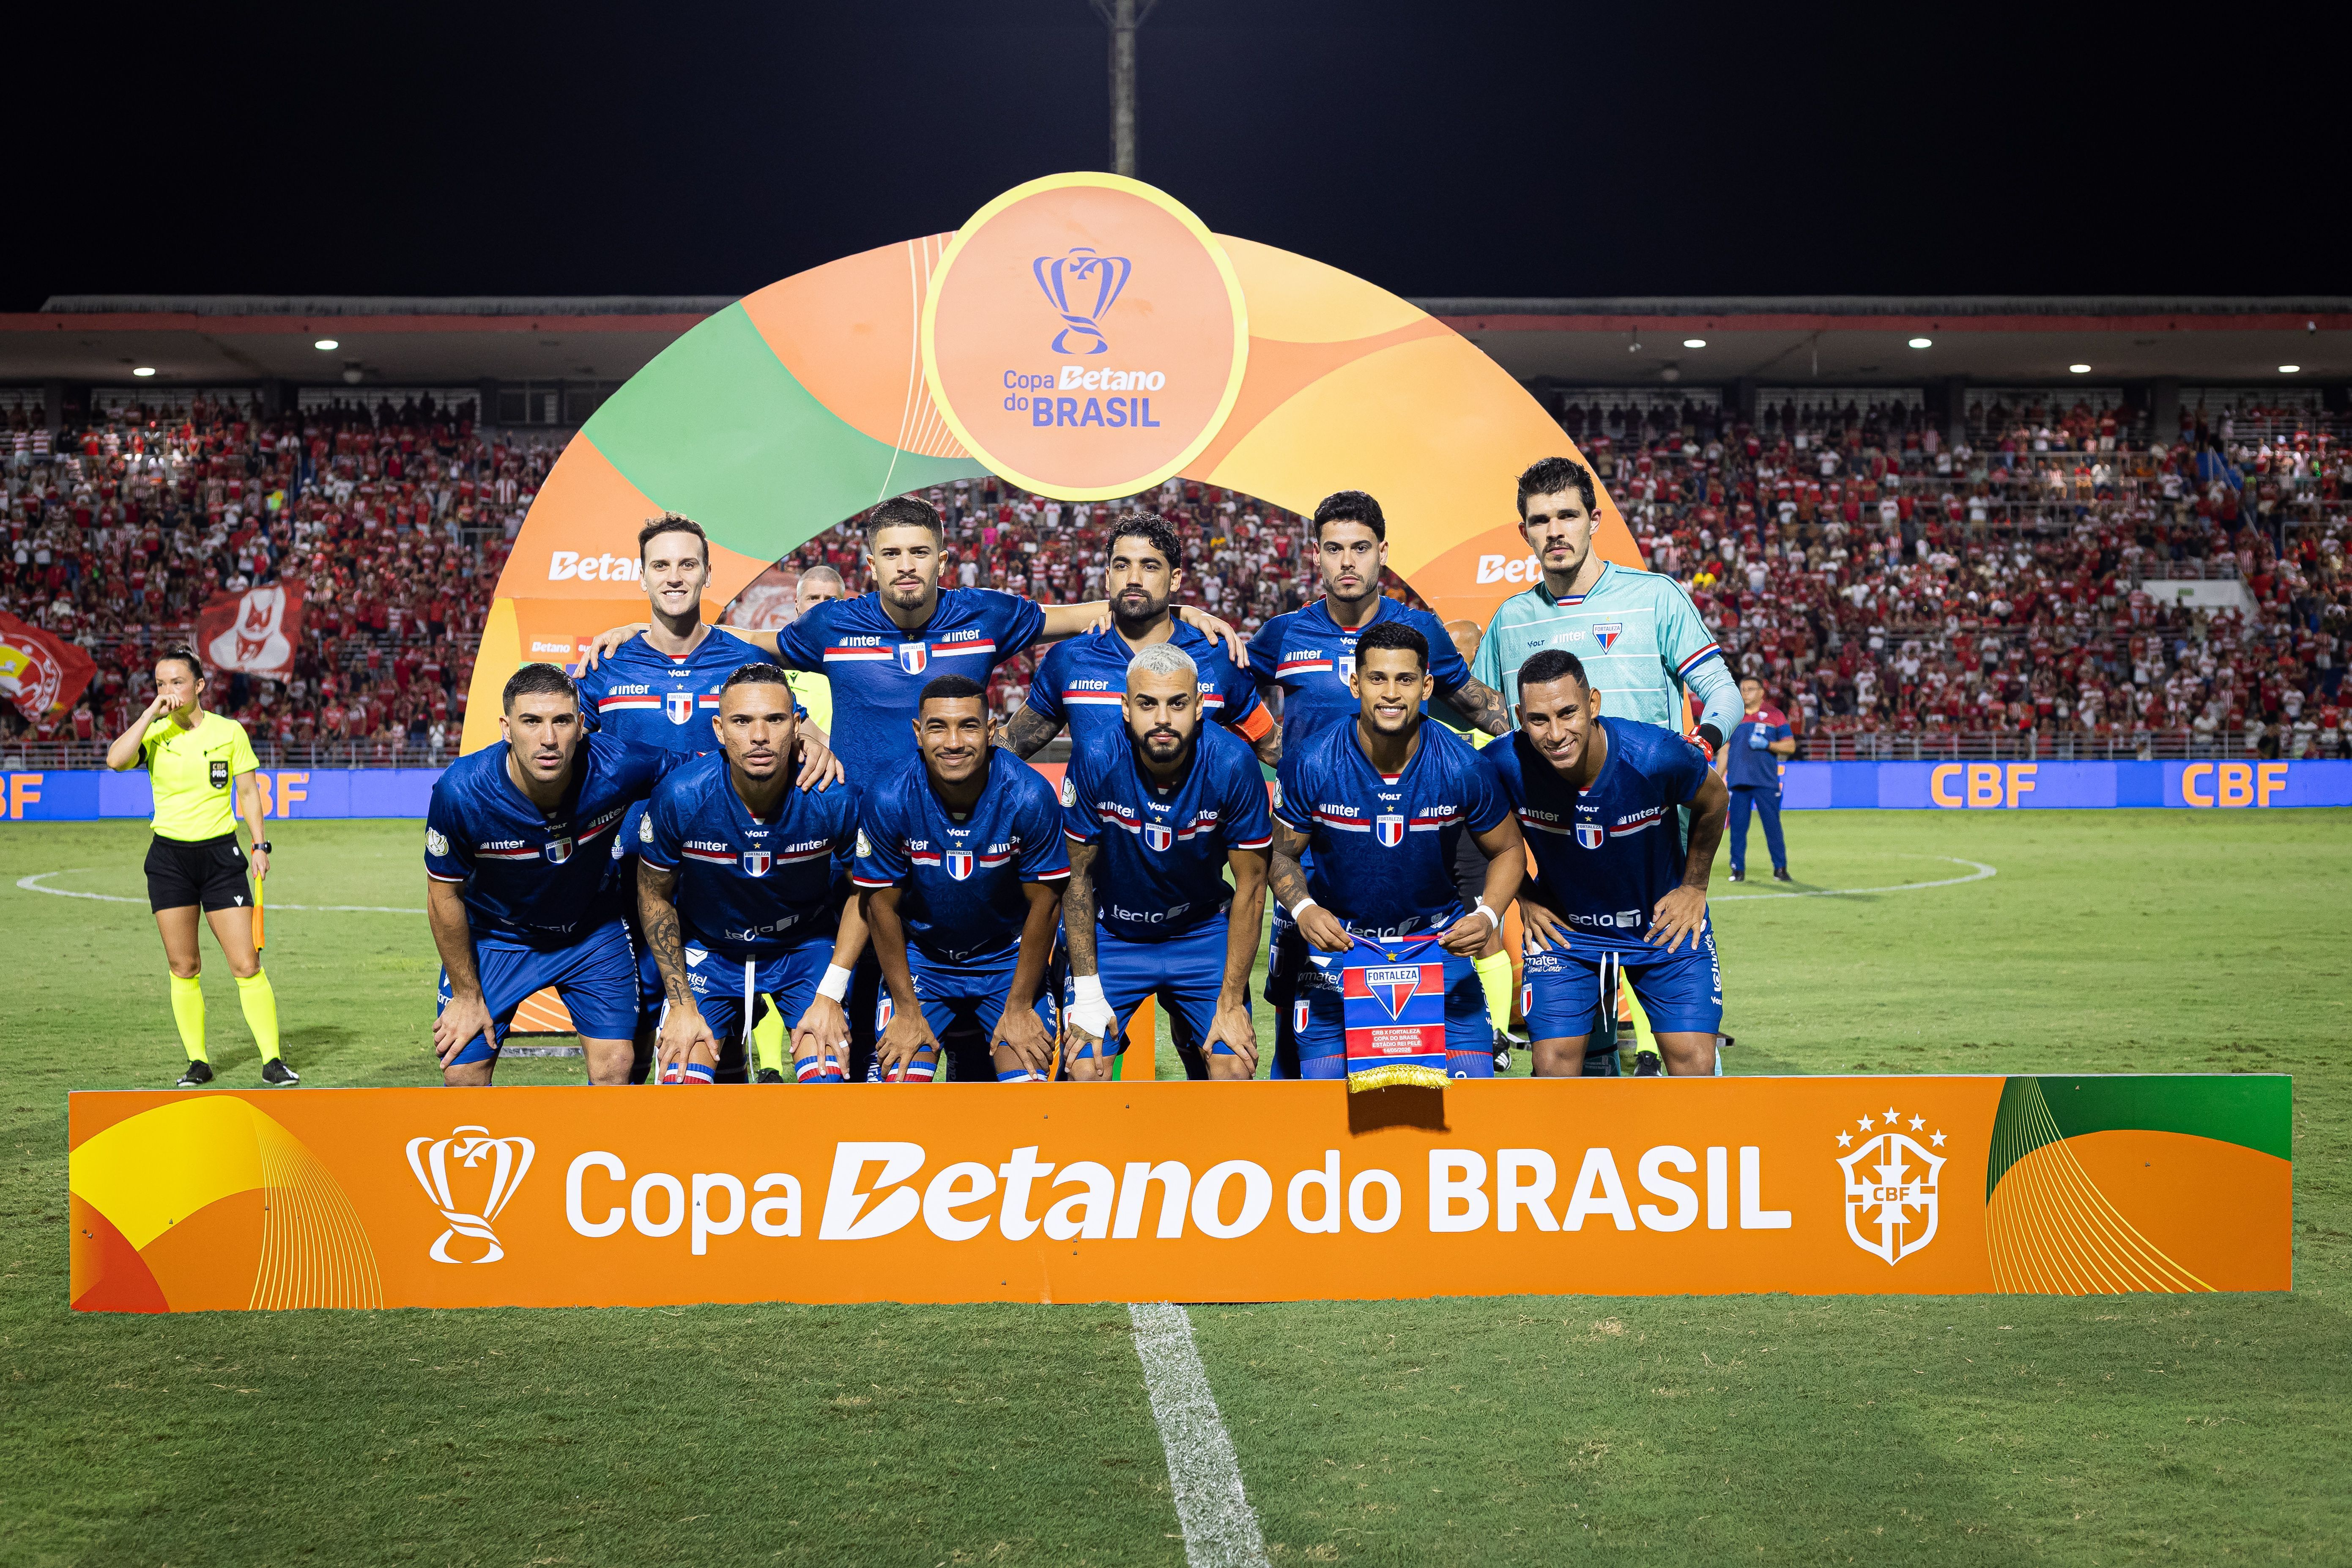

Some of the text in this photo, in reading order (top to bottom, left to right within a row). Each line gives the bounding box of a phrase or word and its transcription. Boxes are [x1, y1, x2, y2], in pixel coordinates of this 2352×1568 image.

[1004, 366, 1166, 392] Copa Betano
[1004, 392, 1161, 427] do BRASIL
[850, 635, 881, 646] inter
[952, 629, 980, 642] inter
[1559, 630, 1586, 643] inter
[531, 641, 570, 653] Betano
[1528, 640, 1545, 648] VOLT
[1293, 649, 1322, 660] inter
[668, 669, 691, 678] VOLT
[619, 683, 650, 694] inter
[1079, 679, 1109, 690] inter
[1197, 681, 1215, 692] ter
[1931, 763, 2038, 808] CBF
[2182, 763, 2289, 807] CBF
[1377, 793, 1402, 801] VOLT
[1147, 801, 1172, 812] VOLT
[1328, 804, 1360, 817] inter
[598, 804, 626, 825] inter
[1528, 809, 1559, 822] inter
[1628, 806, 1660, 823] inter
[544, 822, 567, 832] VOLT
[947, 829, 971, 837] VOLT
[491, 839, 525, 850] inter
[546, 837, 571, 848] FORTALEZA
[694, 840, 728, 851] inter
[797, 838, 828, 851] inter
[1368, 970, 1417, 981] FORTALEZA
[566, 1142, 1792, 1256] Copa Betano do BRASIL
[1873, 1186, 1910, 1201] CBF
